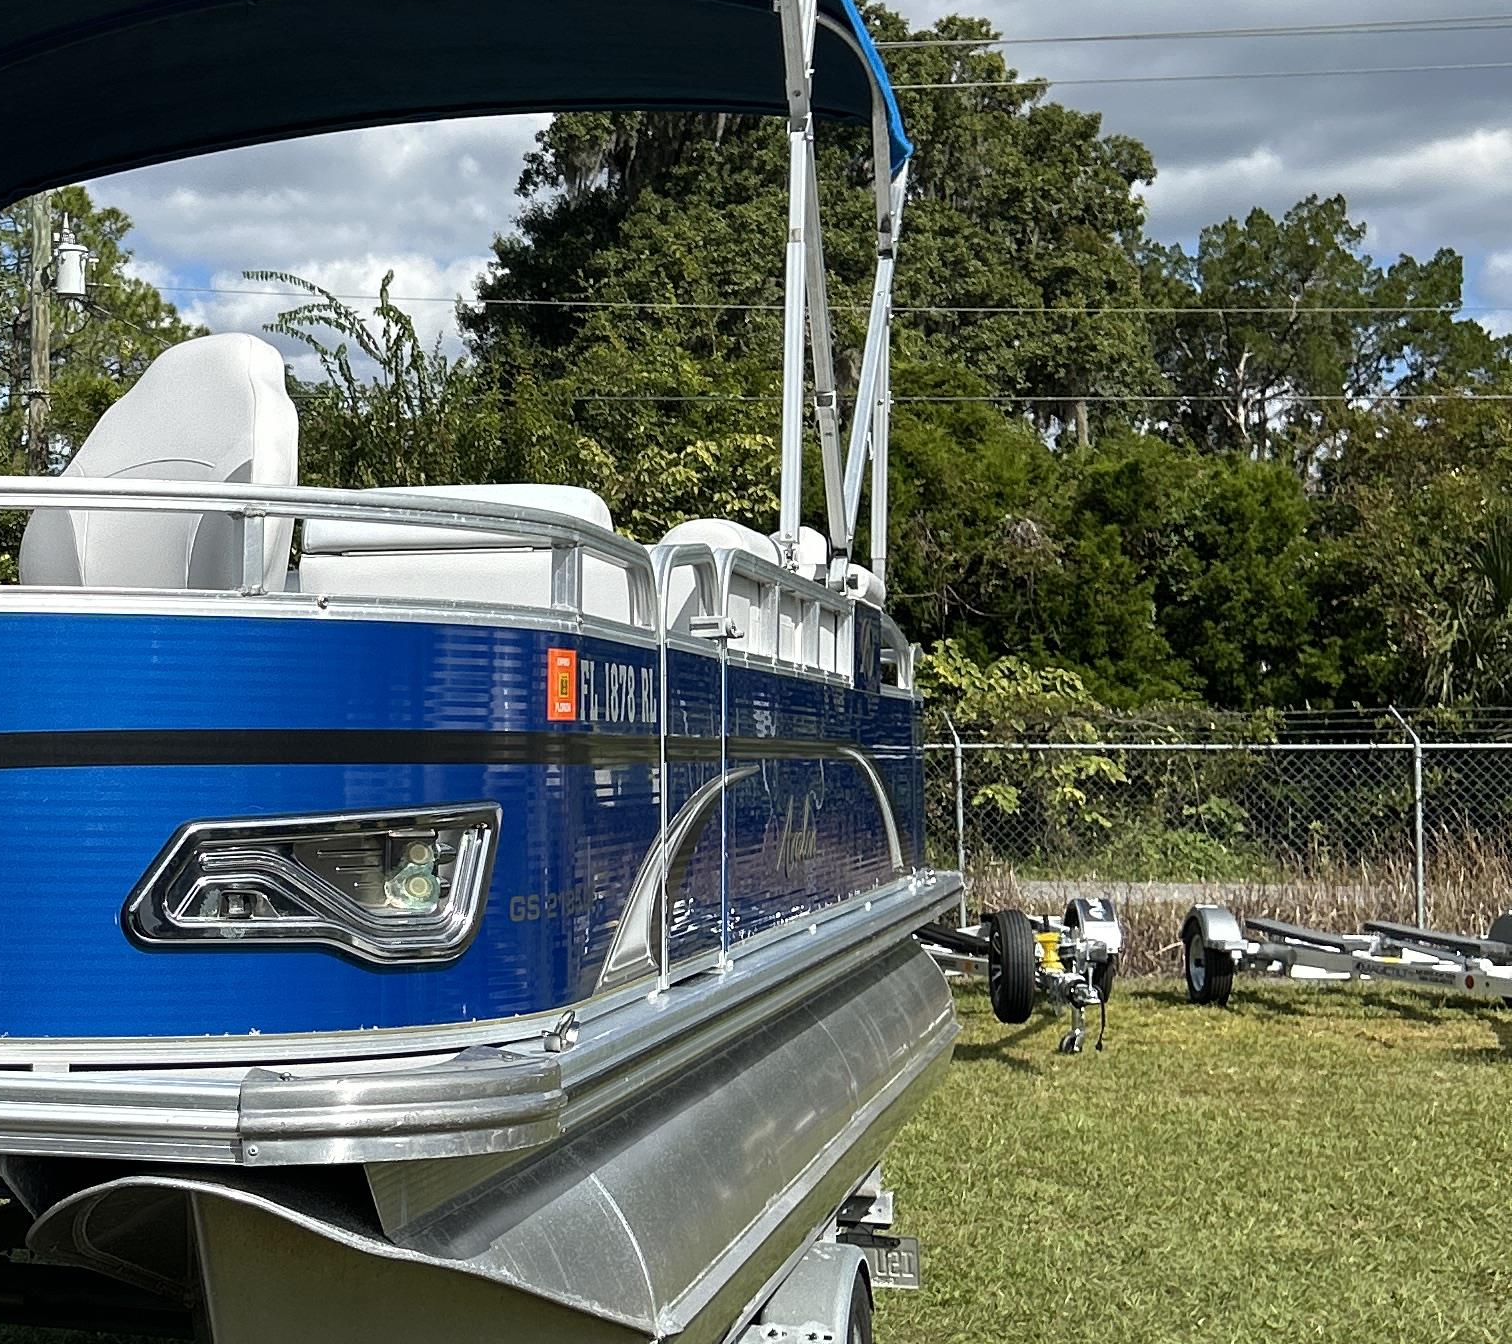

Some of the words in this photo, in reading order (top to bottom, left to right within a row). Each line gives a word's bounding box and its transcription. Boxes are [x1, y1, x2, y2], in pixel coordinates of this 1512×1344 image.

[580, 659, 598, 721] FL
[605, 662, 635, 723] 1878
[641, 667, 657, 723] RL
[509, 894, 540, 922] GS
